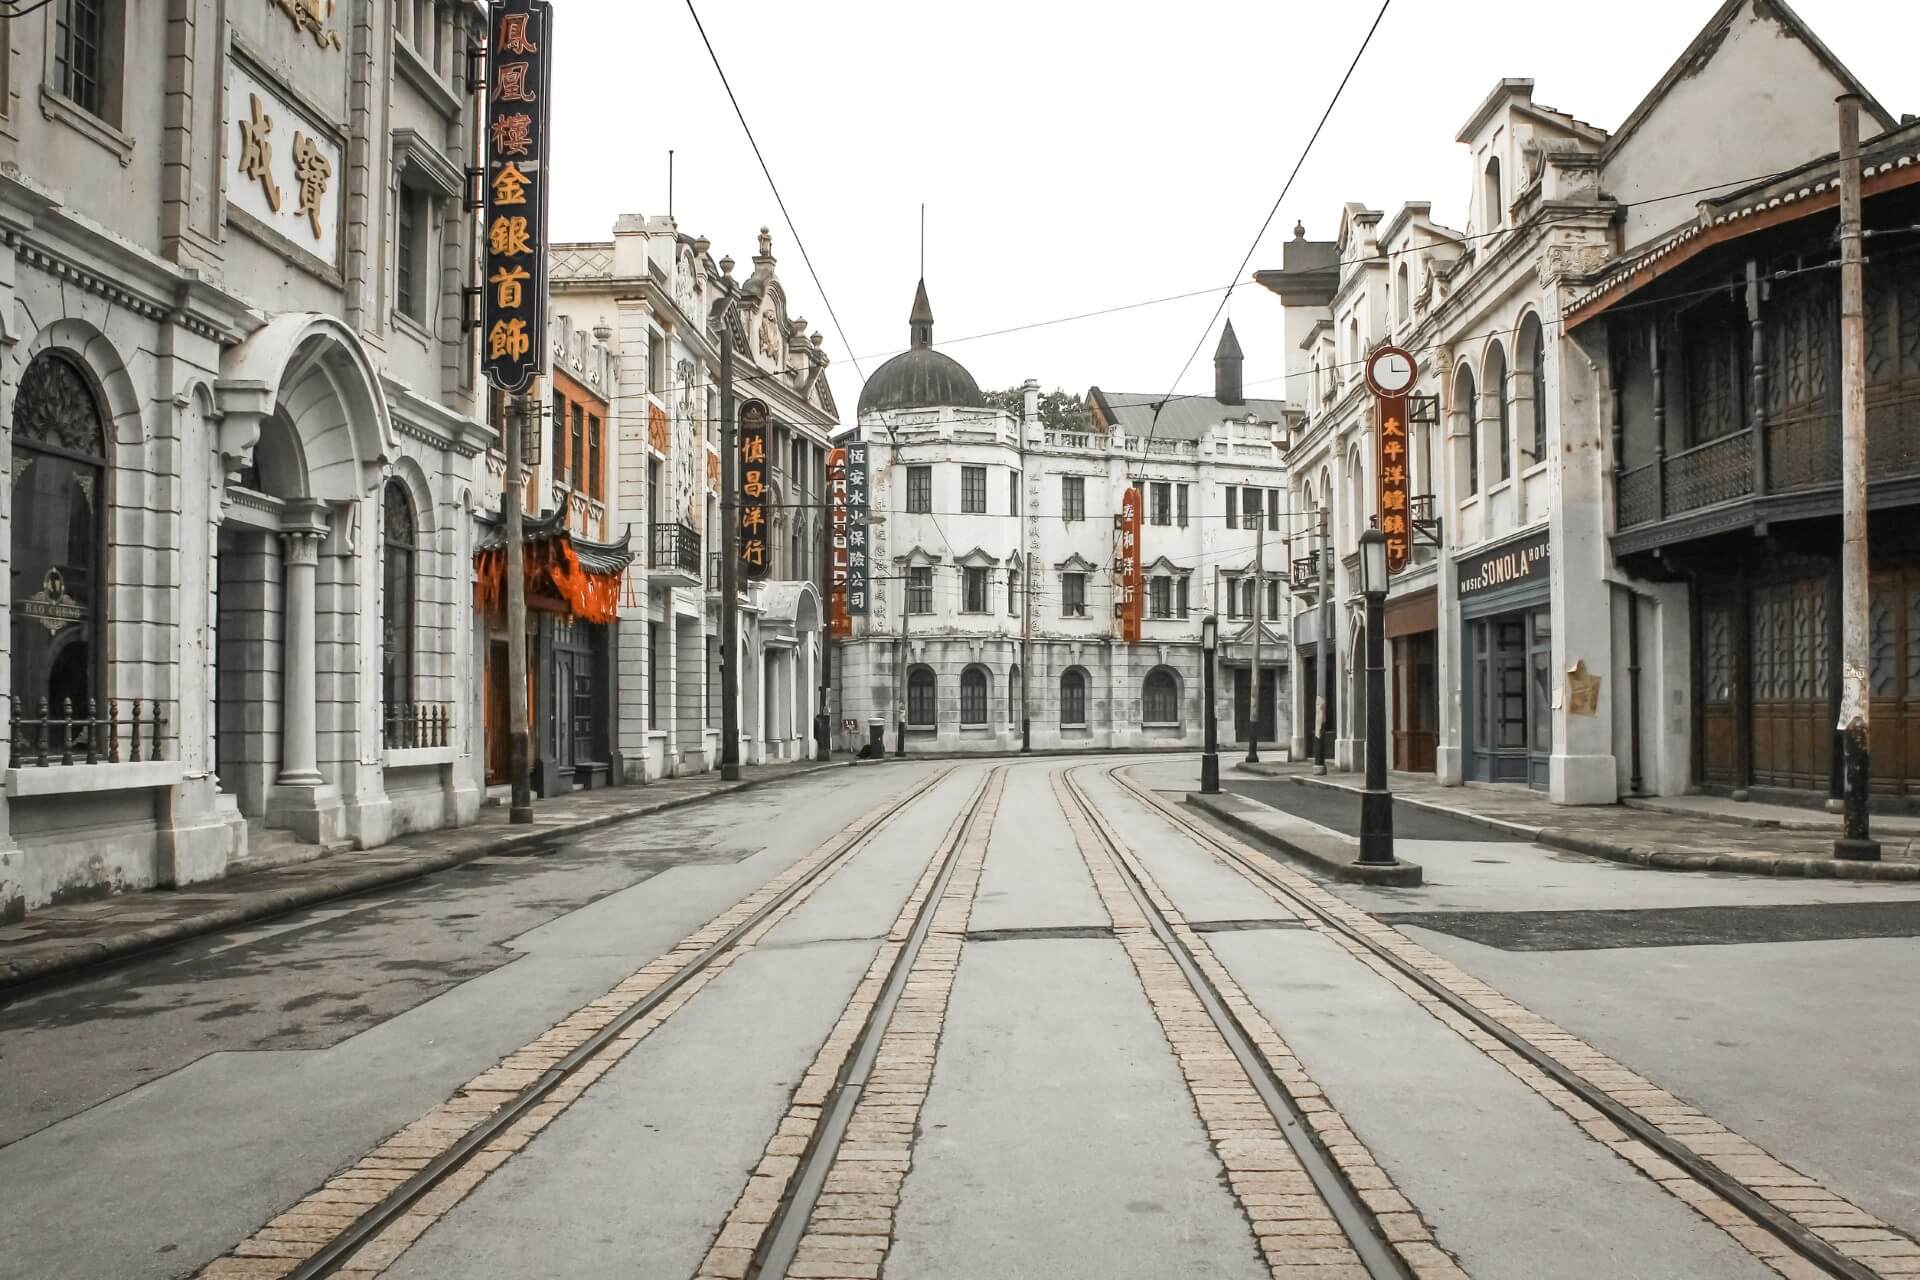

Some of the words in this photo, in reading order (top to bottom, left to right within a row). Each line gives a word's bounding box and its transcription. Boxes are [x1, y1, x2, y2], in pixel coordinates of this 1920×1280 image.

[489, 12, 537, 363] 鳳凰樓金銀首飾
[742, 435, 765, 565] 慎昌洋行
[1460, 576, 1482, 593] MUSIC
[1481, 549, 1529, 588] SONOLA
